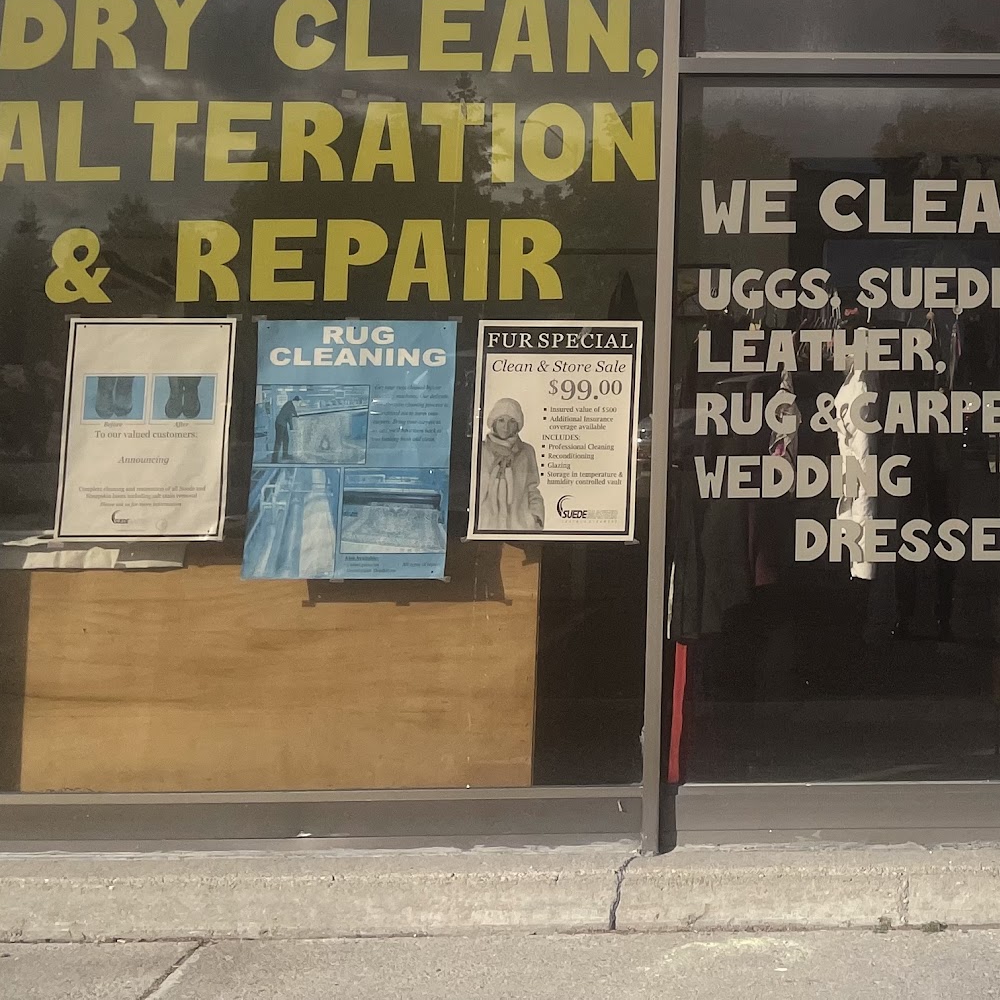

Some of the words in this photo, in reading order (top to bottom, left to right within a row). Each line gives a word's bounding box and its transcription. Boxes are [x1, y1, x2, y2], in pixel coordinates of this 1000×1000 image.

[701, 180, 797, 234] WE
[45, 228, 112, 304] &
[175, 219, 562, 301] REPAIR
[698, 268, 841, 311] UGGS,
[322, 326, 394, 345] RUG
[488, 333, 533, 348] FUR
[538, 333, 633, 349] SPECIAL
[269, 347, 446, 366] CLEANING
[698, 329, 946, 374] LEATHER,
[492, 360, 533, 372] Clean
[537, 360, 549, 372] &
[552, 360, 591, 372] Store
[595, 360, 626, 372] Sale
[549, 379, 622, 400] $99.00
[695, 393, 797, 436] RUG
[810, 393, 840, 433] &
[94, 430, 106, 438] To
[124, 430, 150, 438] valued
[117, 456, 170, 465] Announcing
[547, 462, 570, 470] Glazing
[695, 455, 911, 499] WEDDING
